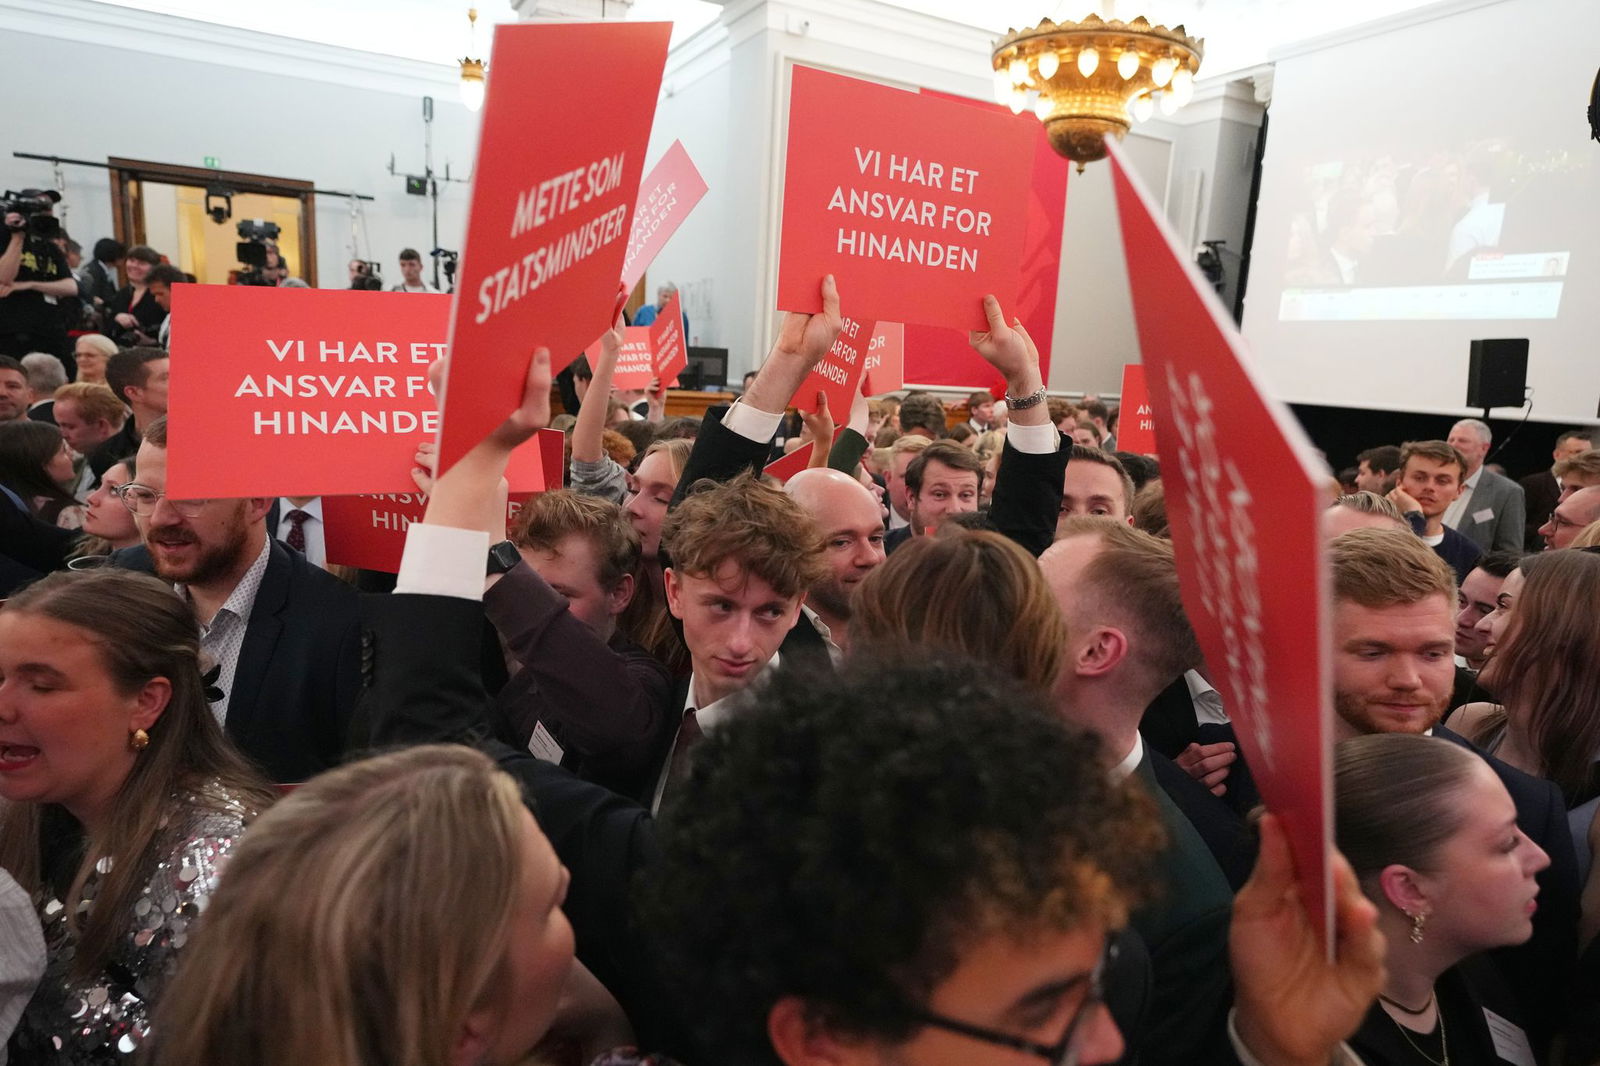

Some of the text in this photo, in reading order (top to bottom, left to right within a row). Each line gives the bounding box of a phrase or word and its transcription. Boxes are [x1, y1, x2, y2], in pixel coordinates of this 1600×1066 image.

[854, 146, 980, 195] VI HAR ET
[511, 152, 625, 239] METTE SOM
[827, 186, 992, 237] ANSVAR FOR
[837, 228, 979, 273] HINANDEN
[475, 203, 627, 324] STATSMINISTER
[266, 339, 448, 364] VI HAR ET
[841, 344, 857, 365] FOR
[868, 336, 886, 351] OR
[614, 363, 653, 373] INANDE
[617, 353, 652, 363] VAR FO
[813, 359, 849, 387] NANDEN
[234, 374, 397, 398] ANSVAR
[254, 410, 440, 435] HINANDE
